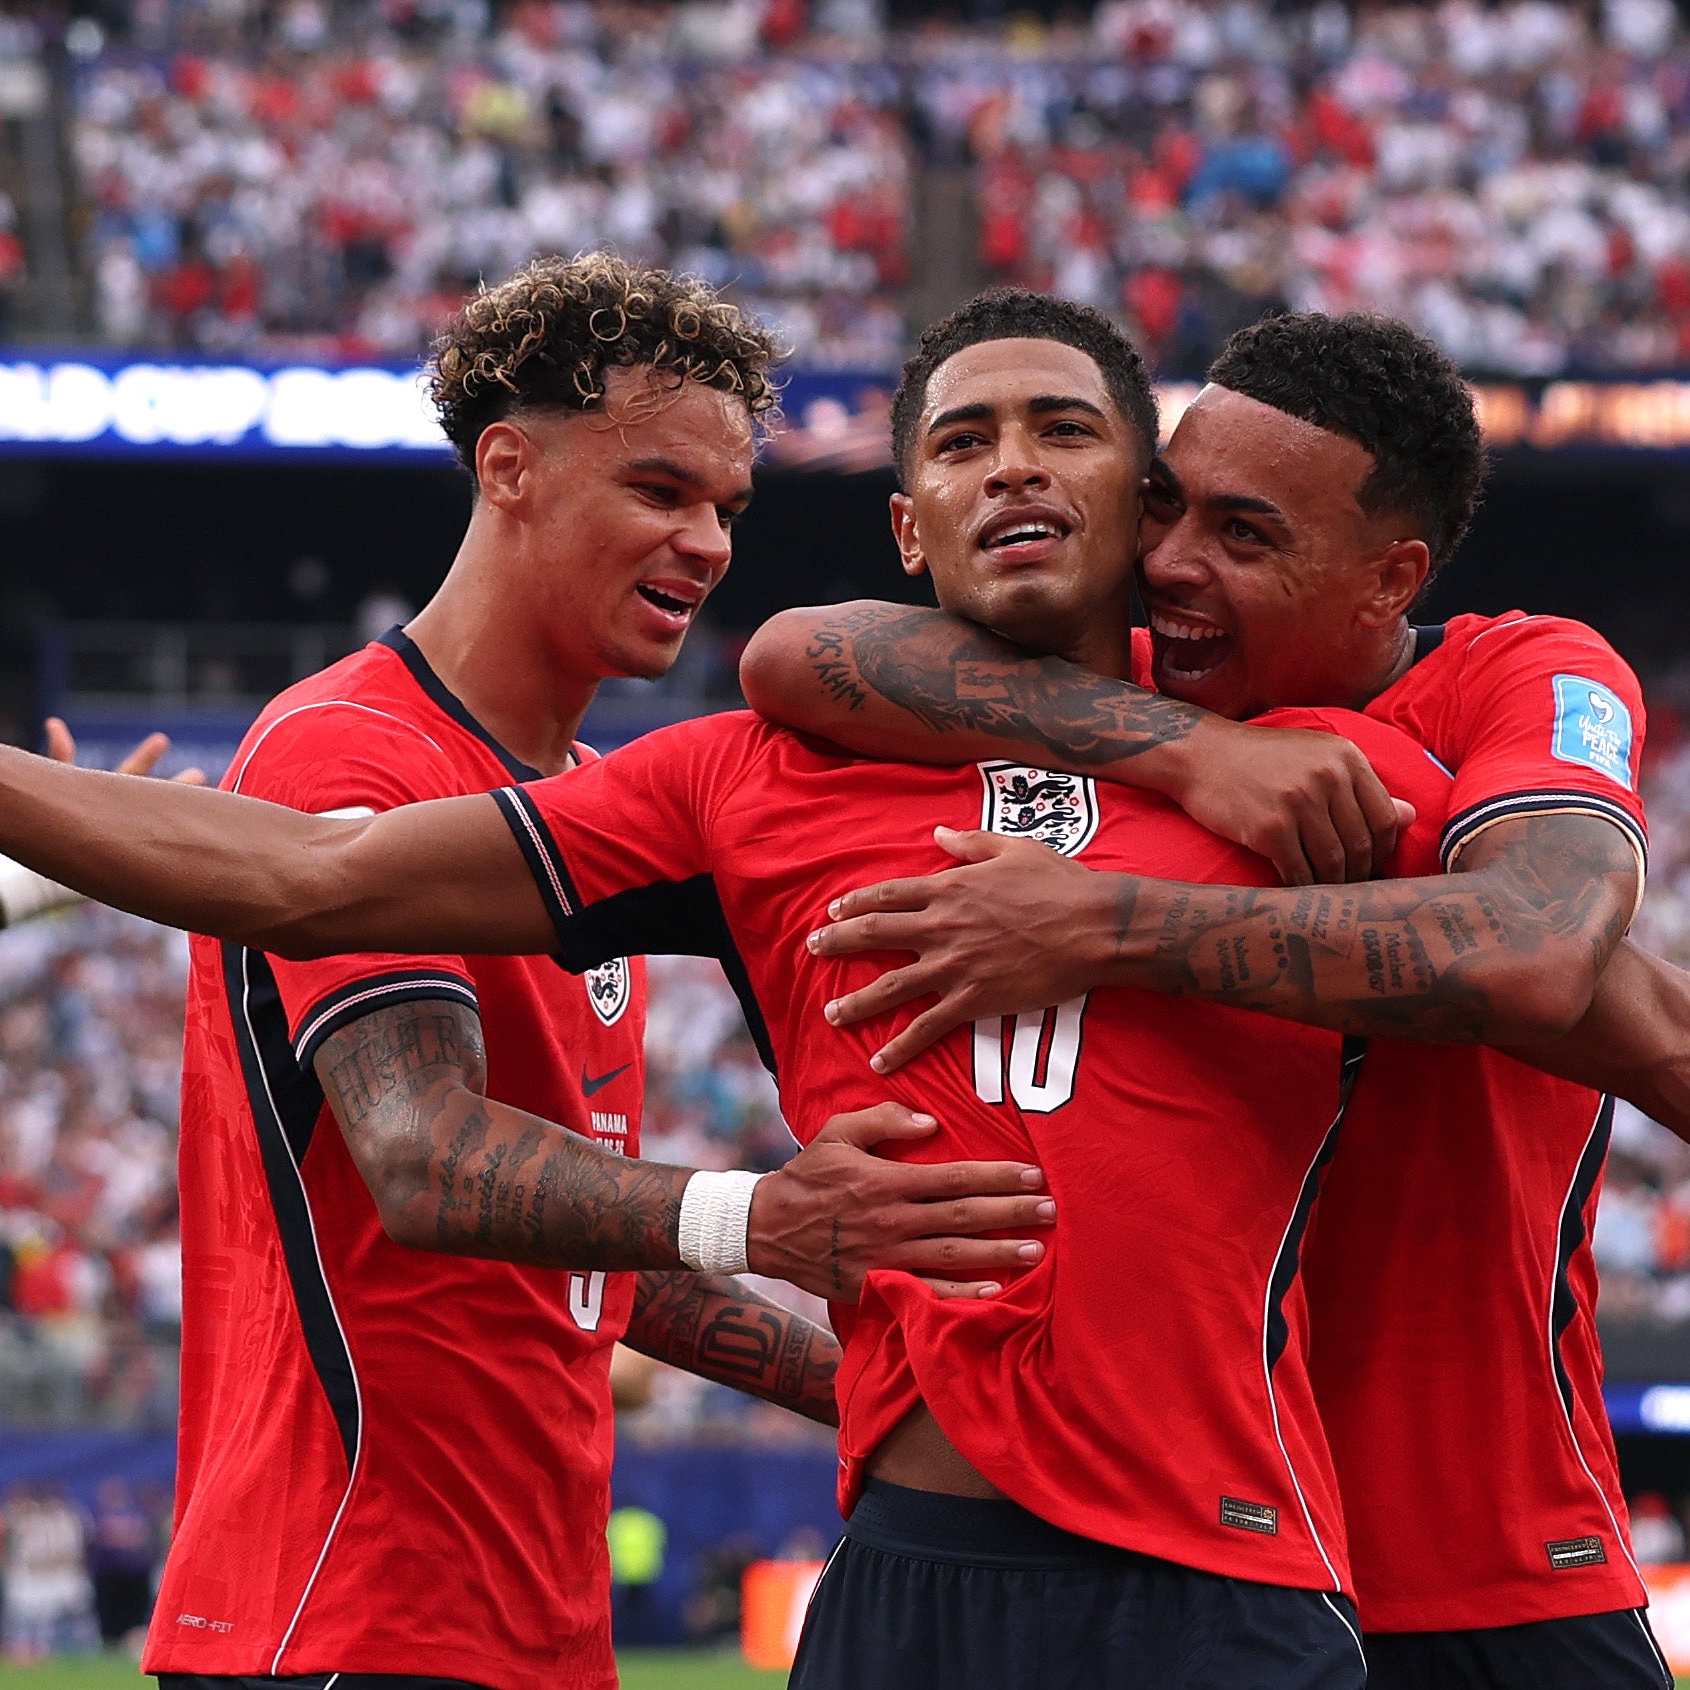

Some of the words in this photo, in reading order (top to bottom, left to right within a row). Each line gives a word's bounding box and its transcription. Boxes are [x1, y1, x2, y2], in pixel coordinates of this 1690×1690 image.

[1582, 730, 1619, 765] PEACE
[1589, 751, 1613, 770] FIFA
[1385, 932, 1406, 989] Mother
[591, 1110, 628, 1135] PANAMA
